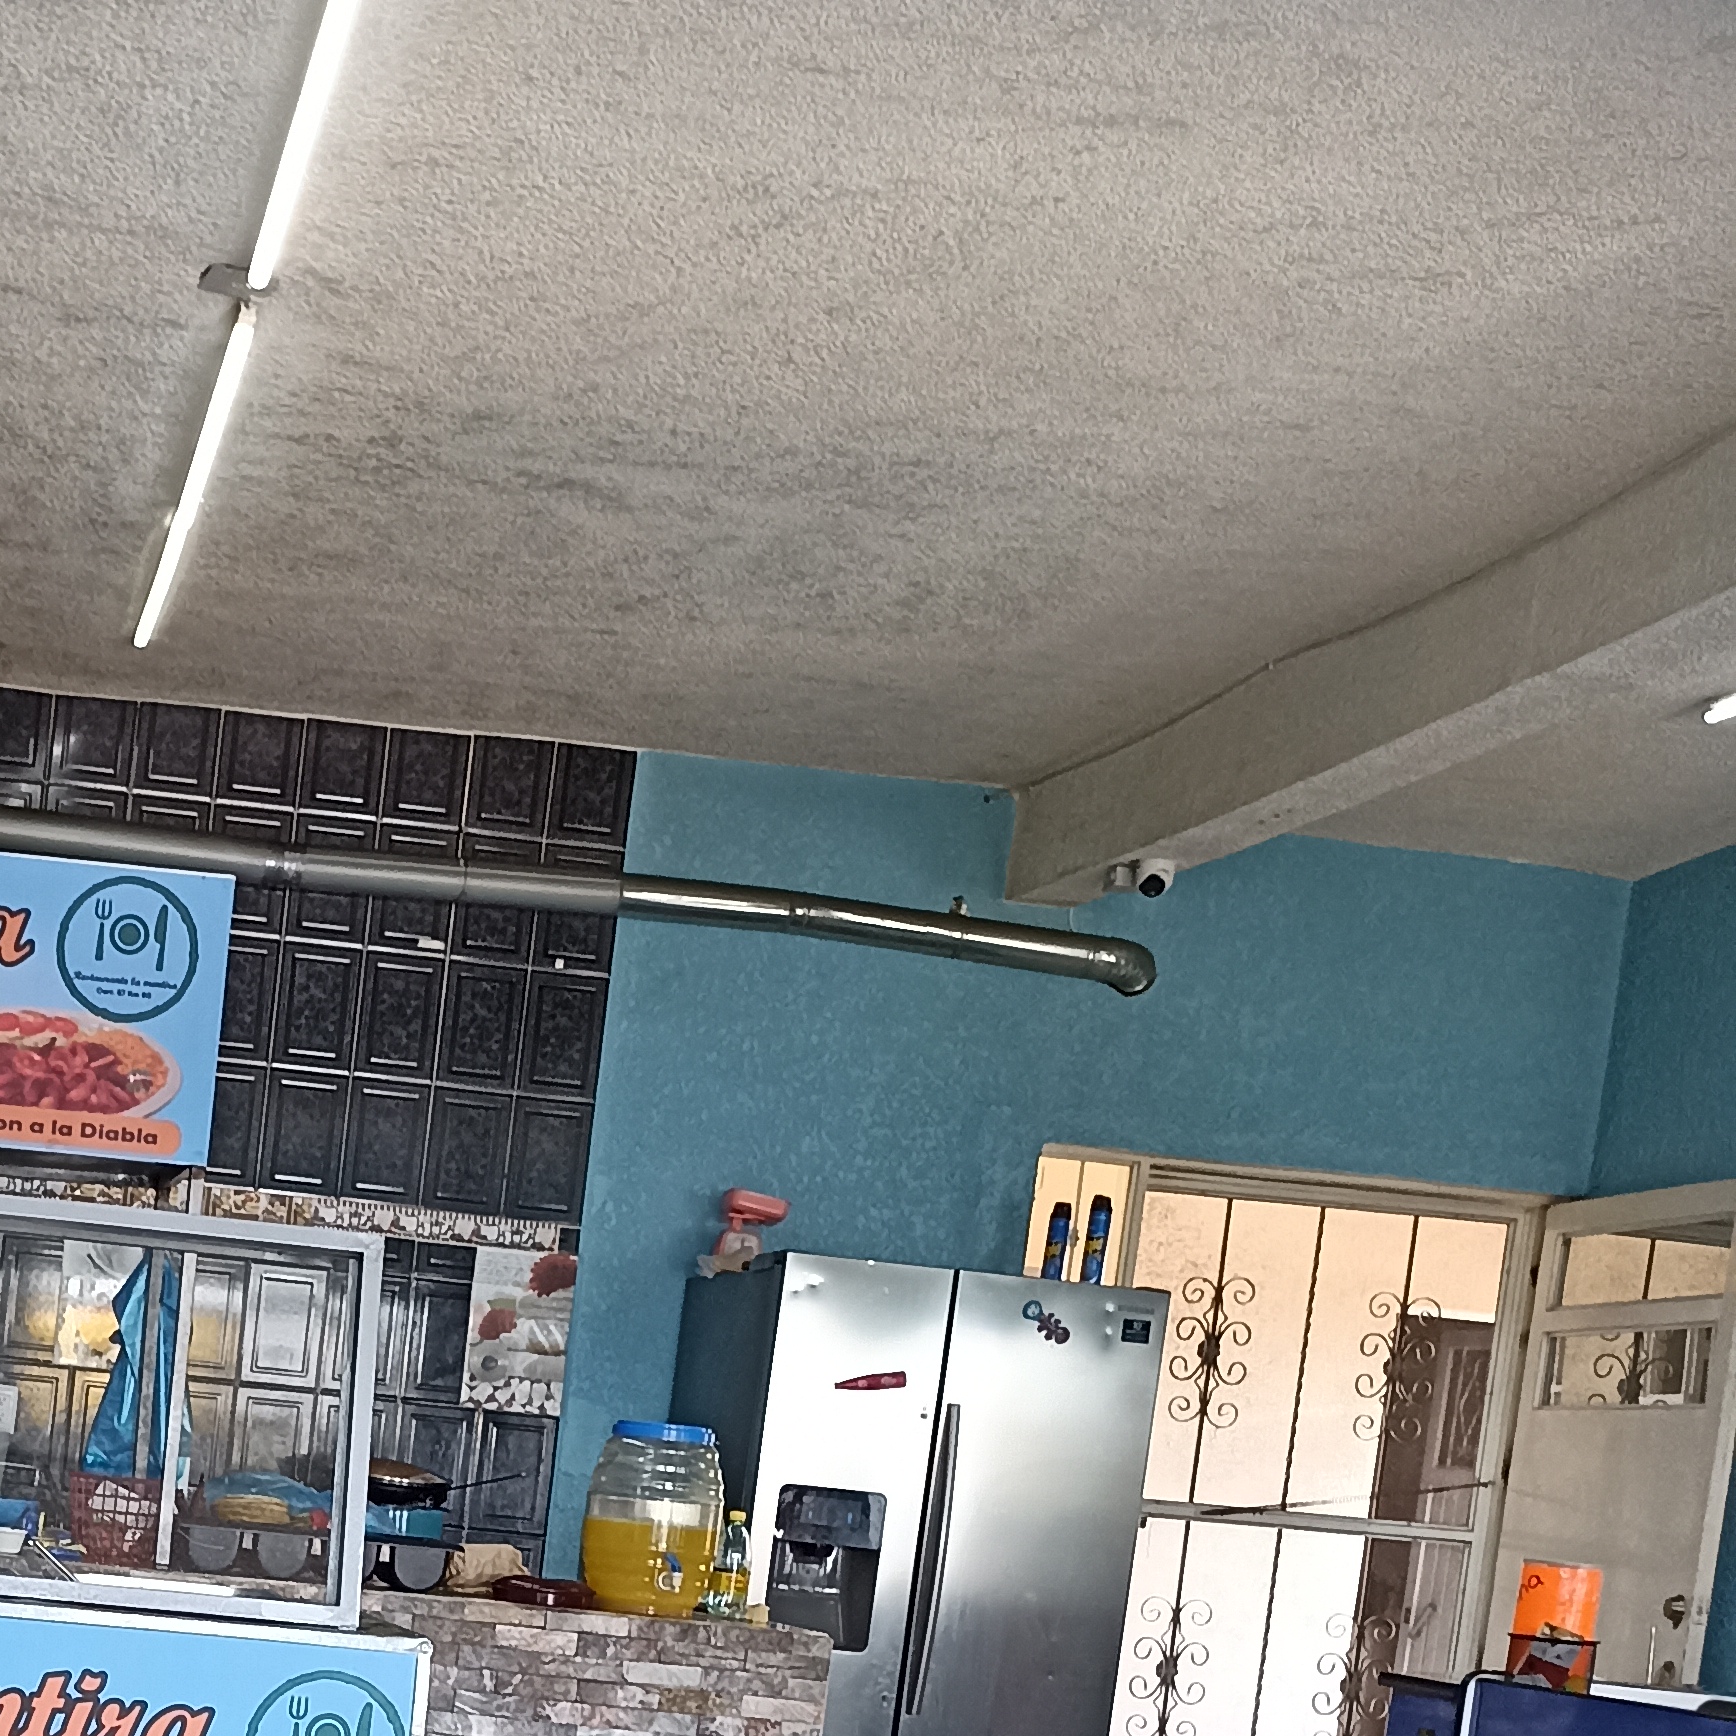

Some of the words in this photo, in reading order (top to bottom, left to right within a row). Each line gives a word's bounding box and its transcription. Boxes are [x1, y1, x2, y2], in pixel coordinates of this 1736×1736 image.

[29, 1122, 44, 1134] a
[51, 1120, 72, 1137] la
[80, 1122, 158, 1146] Diabla
